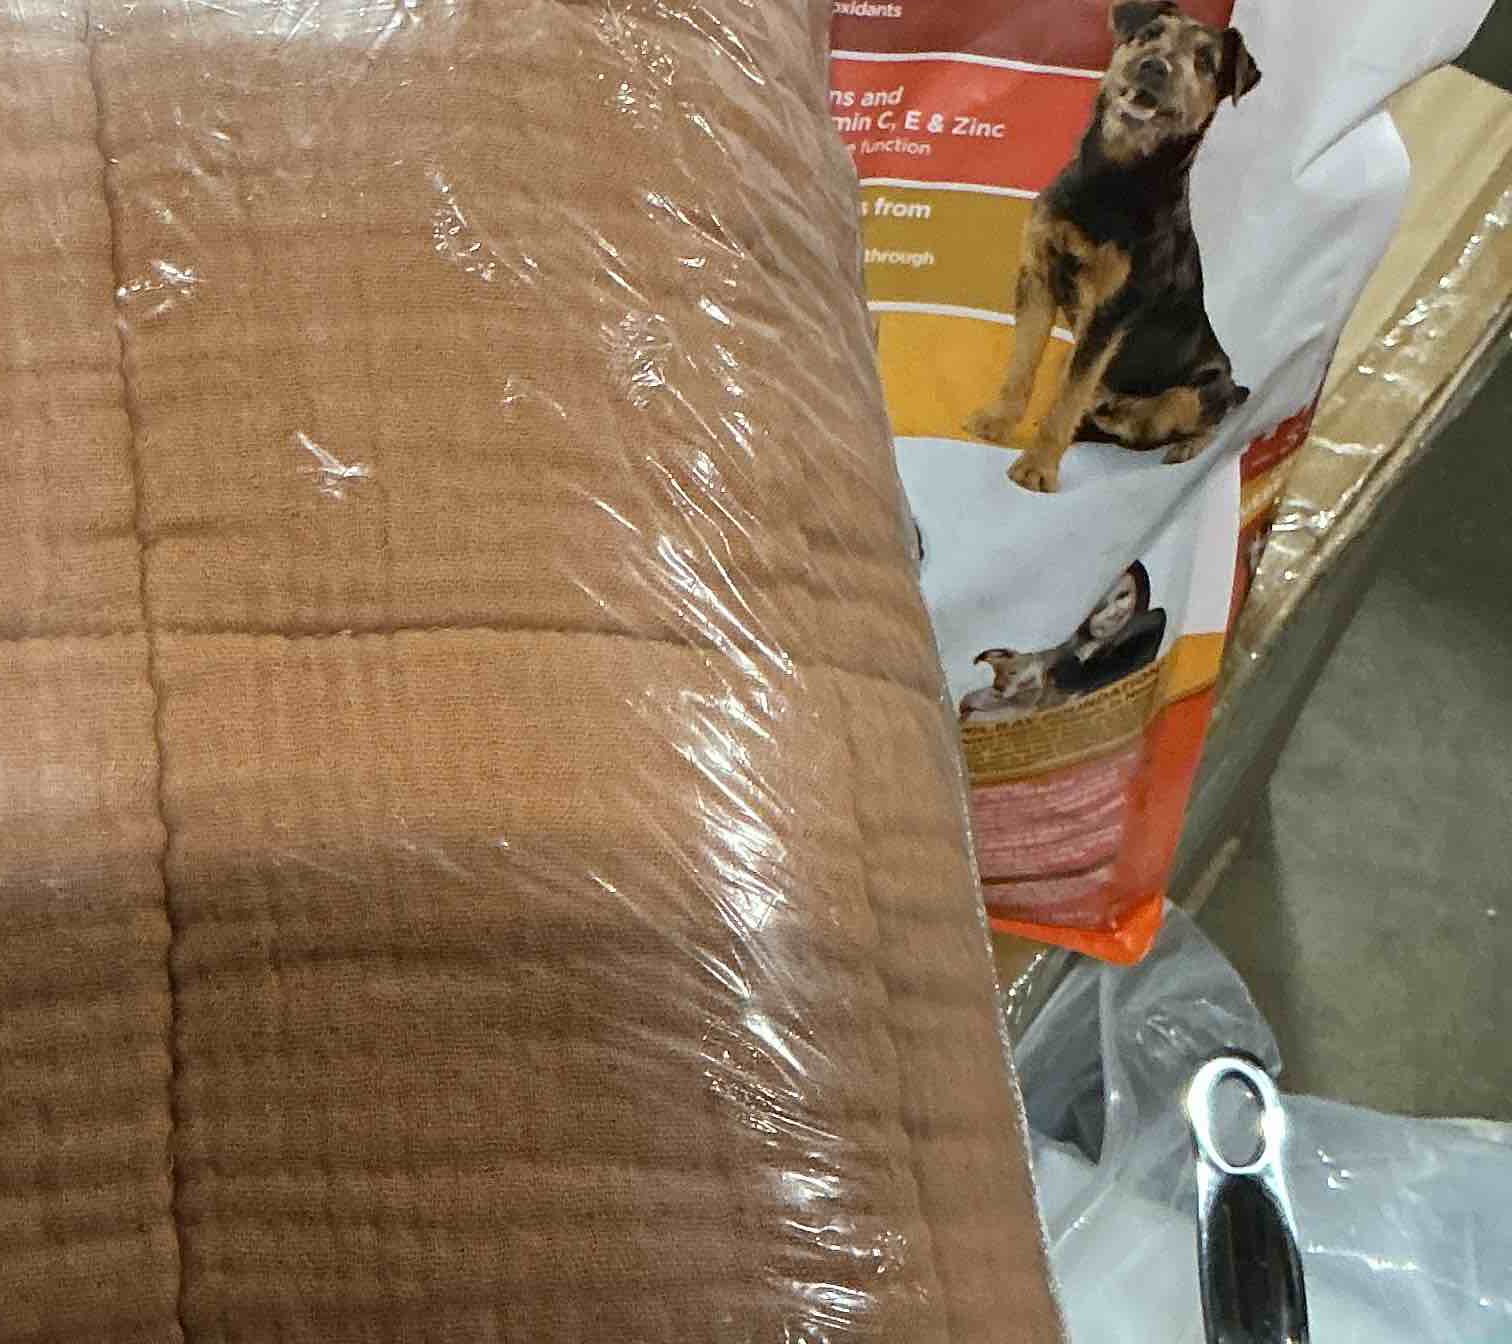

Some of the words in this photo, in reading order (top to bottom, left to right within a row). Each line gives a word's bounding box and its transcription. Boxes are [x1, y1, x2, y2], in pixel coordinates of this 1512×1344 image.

[861, 85, 905, 107] and
[904, 110, 922, 131] E
[927, 113, 945, 134] &
[951, 116, 1008, 138] Zinc
[874, 197, 932, 219] from
